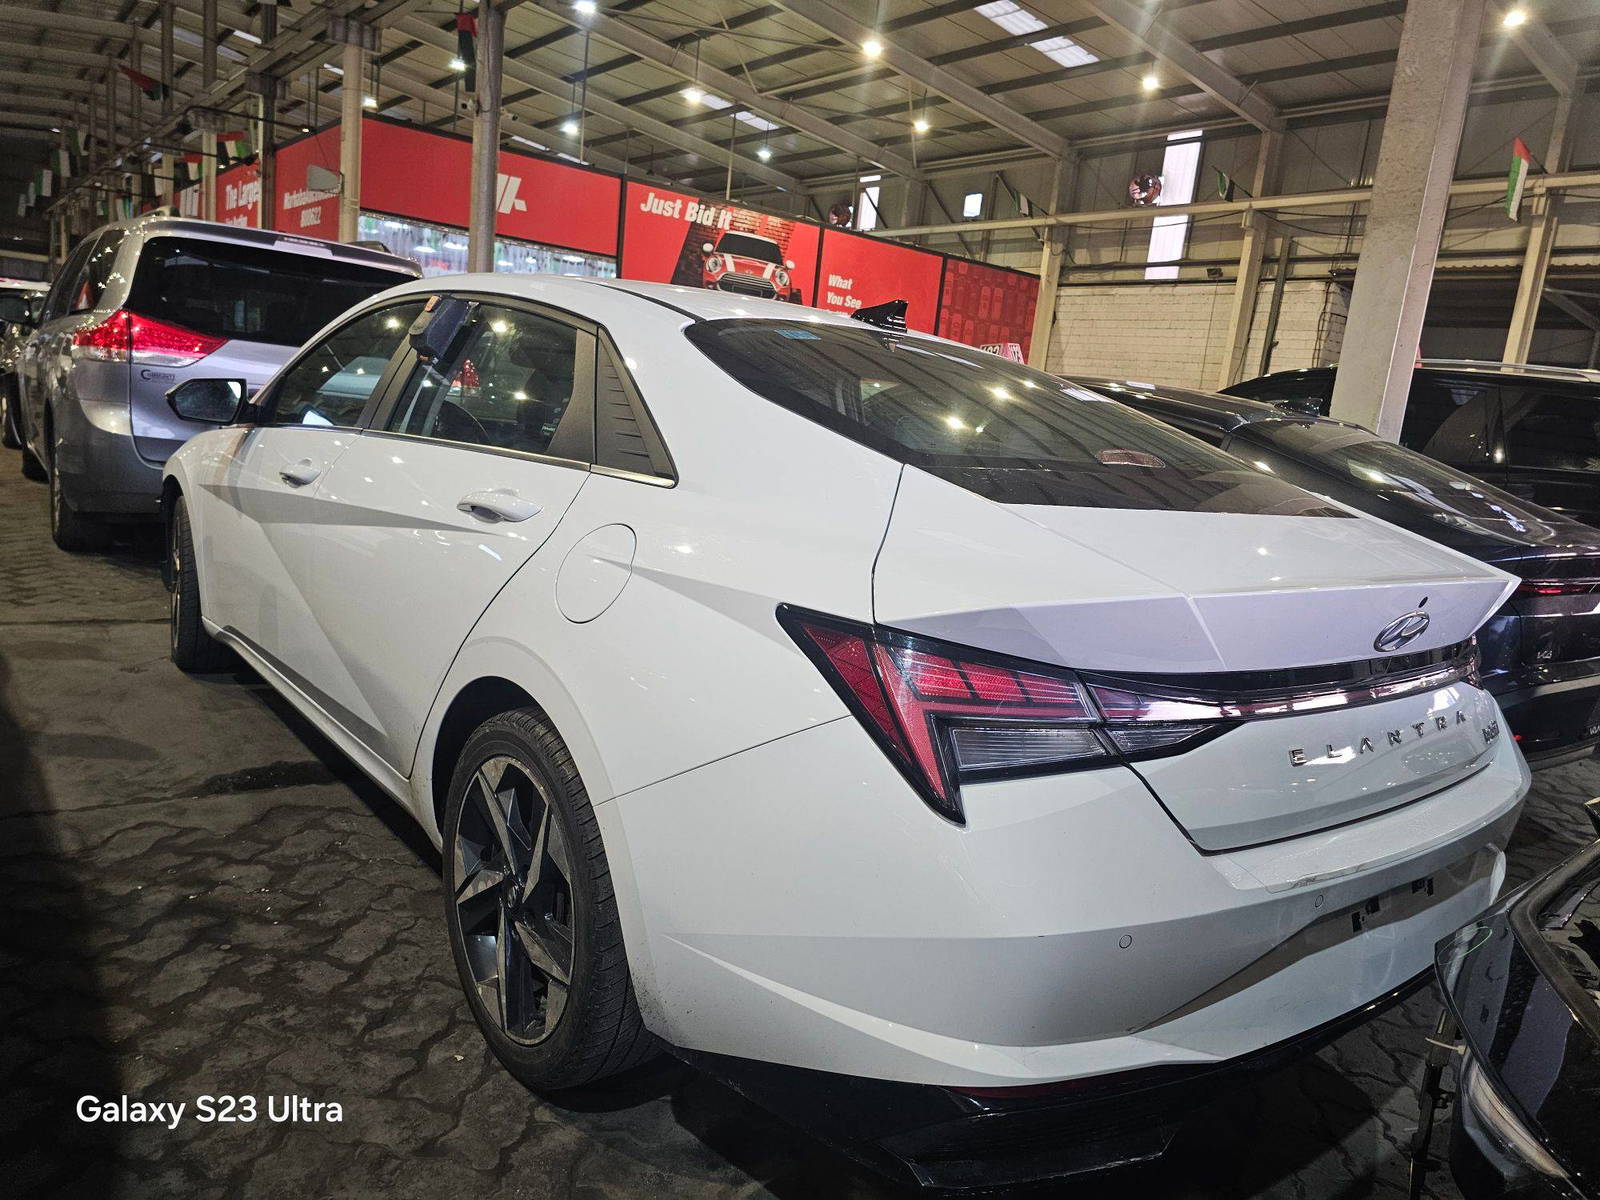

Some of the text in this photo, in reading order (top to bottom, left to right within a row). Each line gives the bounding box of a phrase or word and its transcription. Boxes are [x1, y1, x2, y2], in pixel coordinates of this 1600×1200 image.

[238, 180, 261, 210] Large
[640, 192, 682, 219] Just
[684, 201, 716, 226] Bid
[828, 274, 853, 290] What
[826, 291, 862, 309] You See
[1289, 710, 1466, 767] ELANTRA
